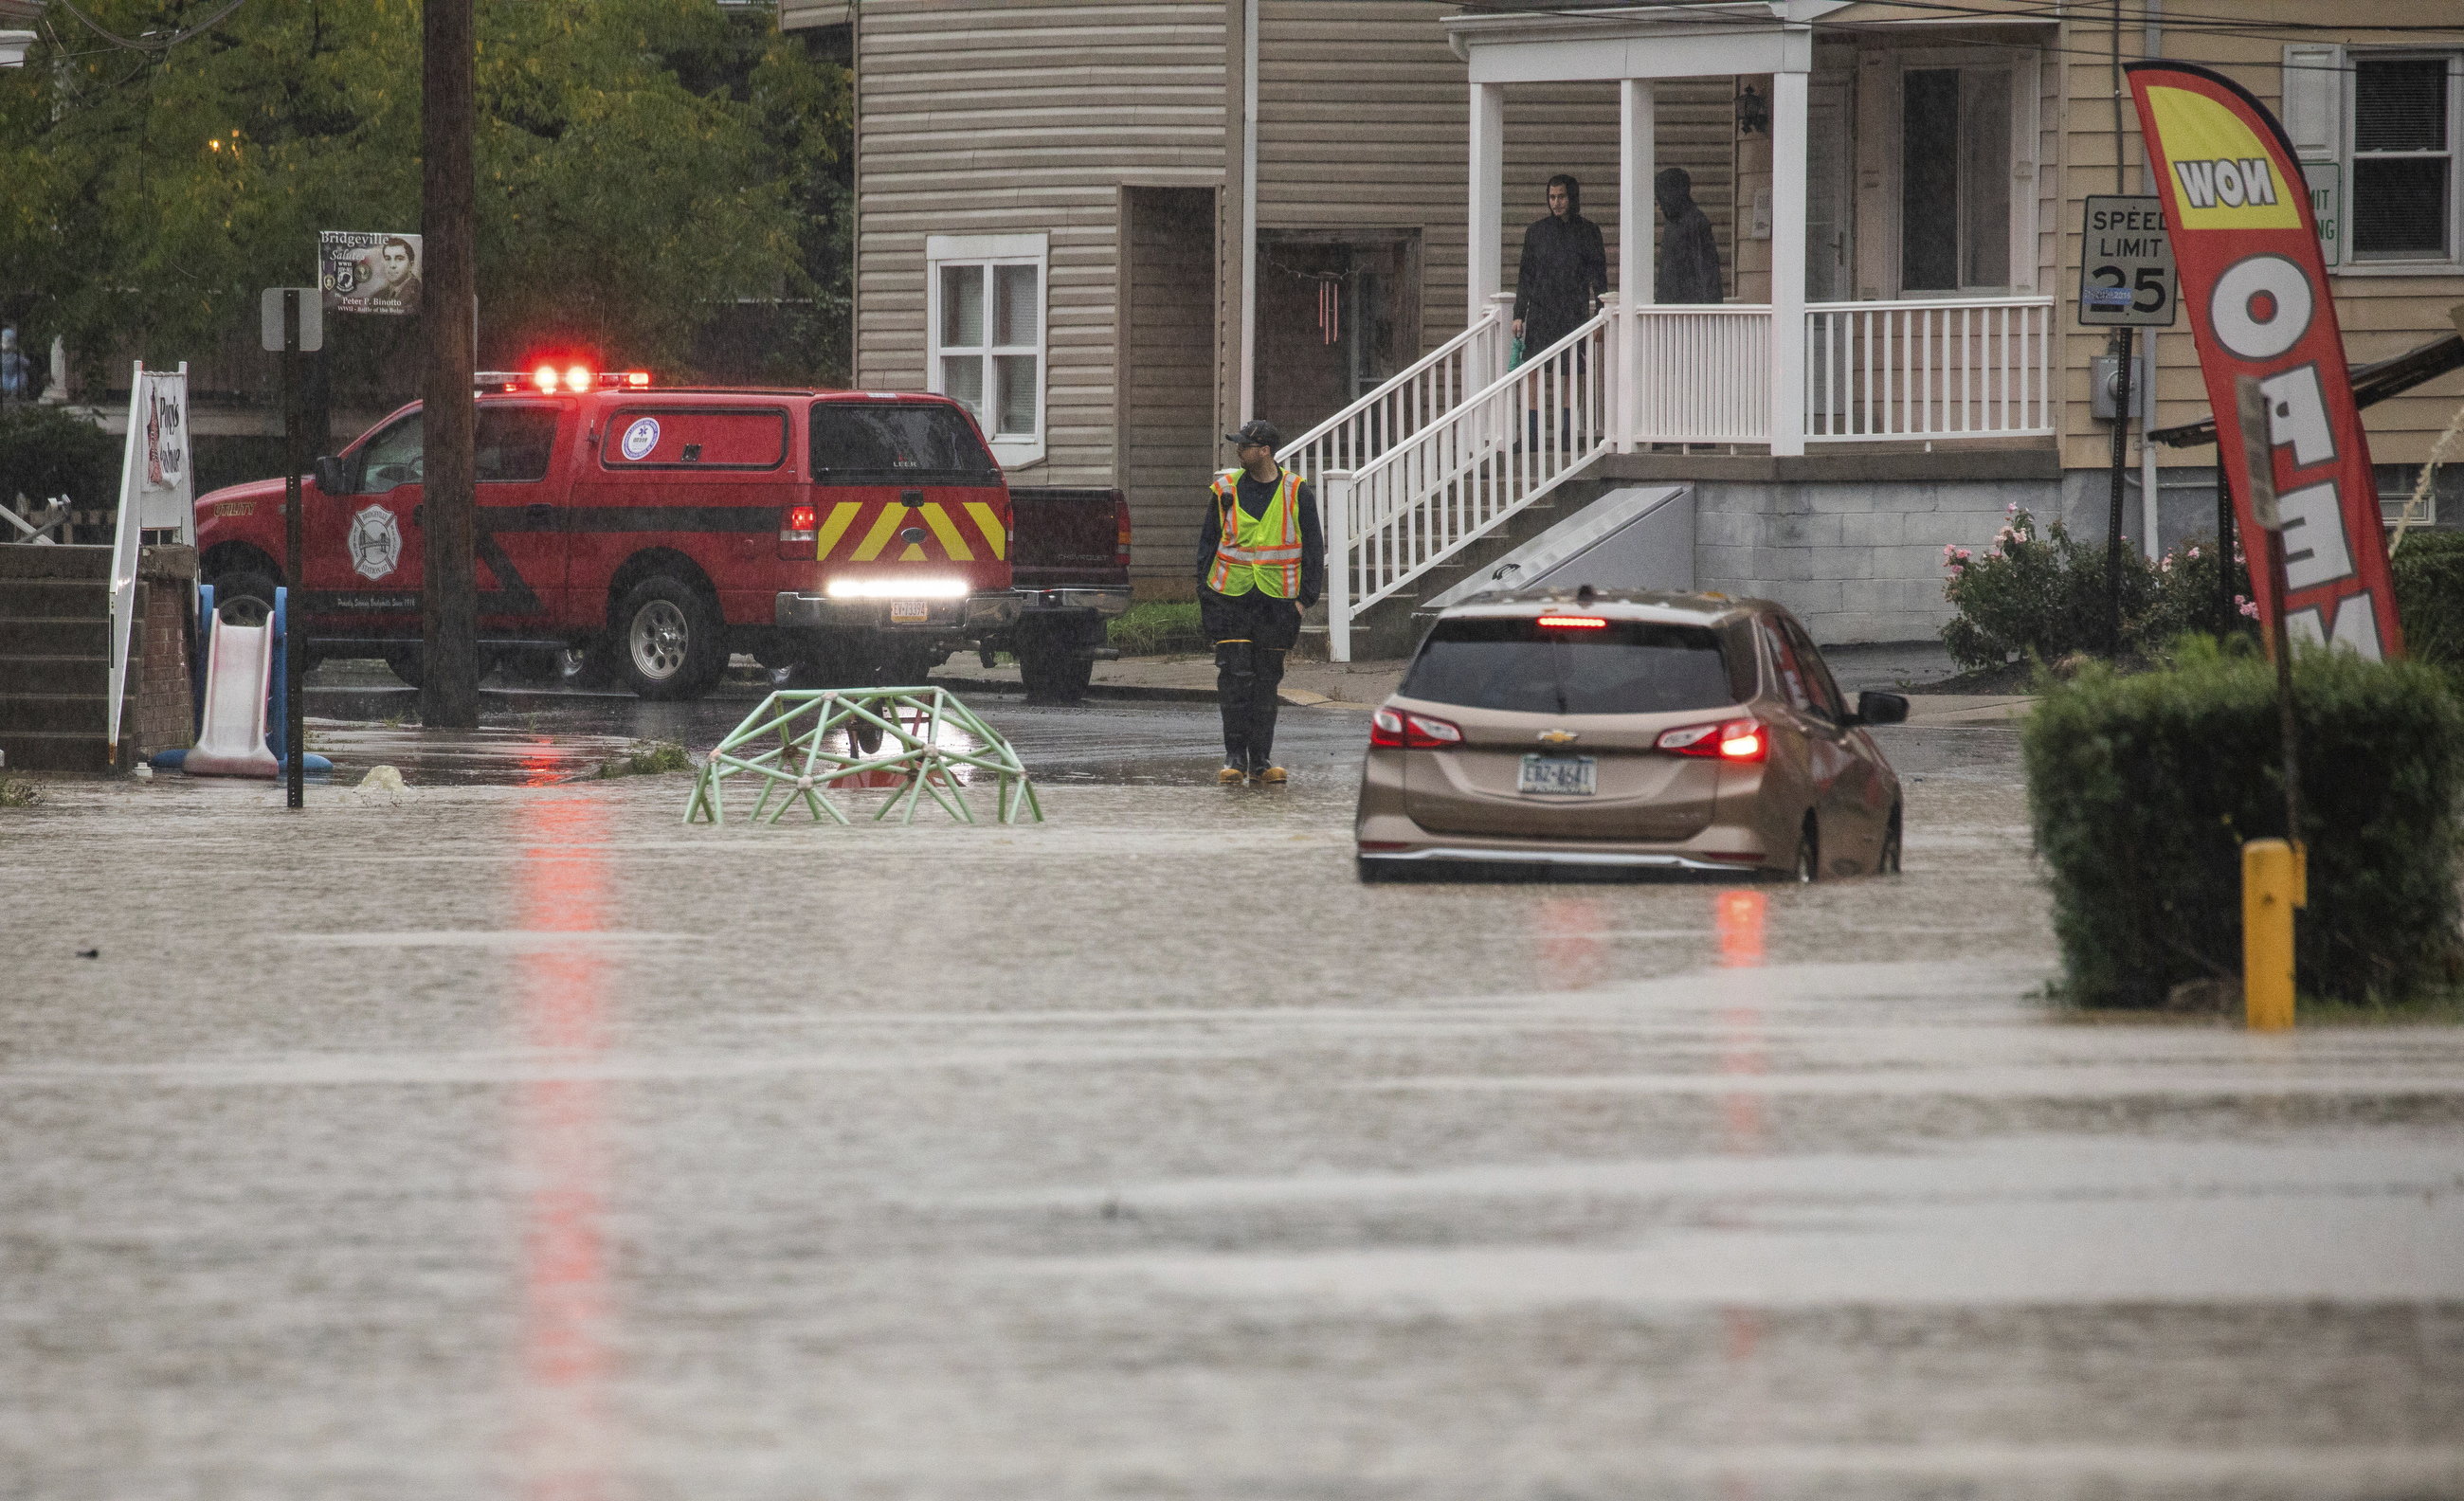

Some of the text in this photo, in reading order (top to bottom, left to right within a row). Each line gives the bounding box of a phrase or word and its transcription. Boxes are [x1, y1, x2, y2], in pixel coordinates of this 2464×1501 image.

[321, 232, 390, 247] Bridgeville
[330, 248, 366, 261] Salutes
[2100, 238, 2163, 258] LIMIT
[2090, 265, 2166, 314] 25
[342, 298, 362, 306] Peter
[373, 298, 402, 306] Binotto
[214, 502, 256, 517] UTILITY
[1057, 552, 1109, 562] CHEVROLET
